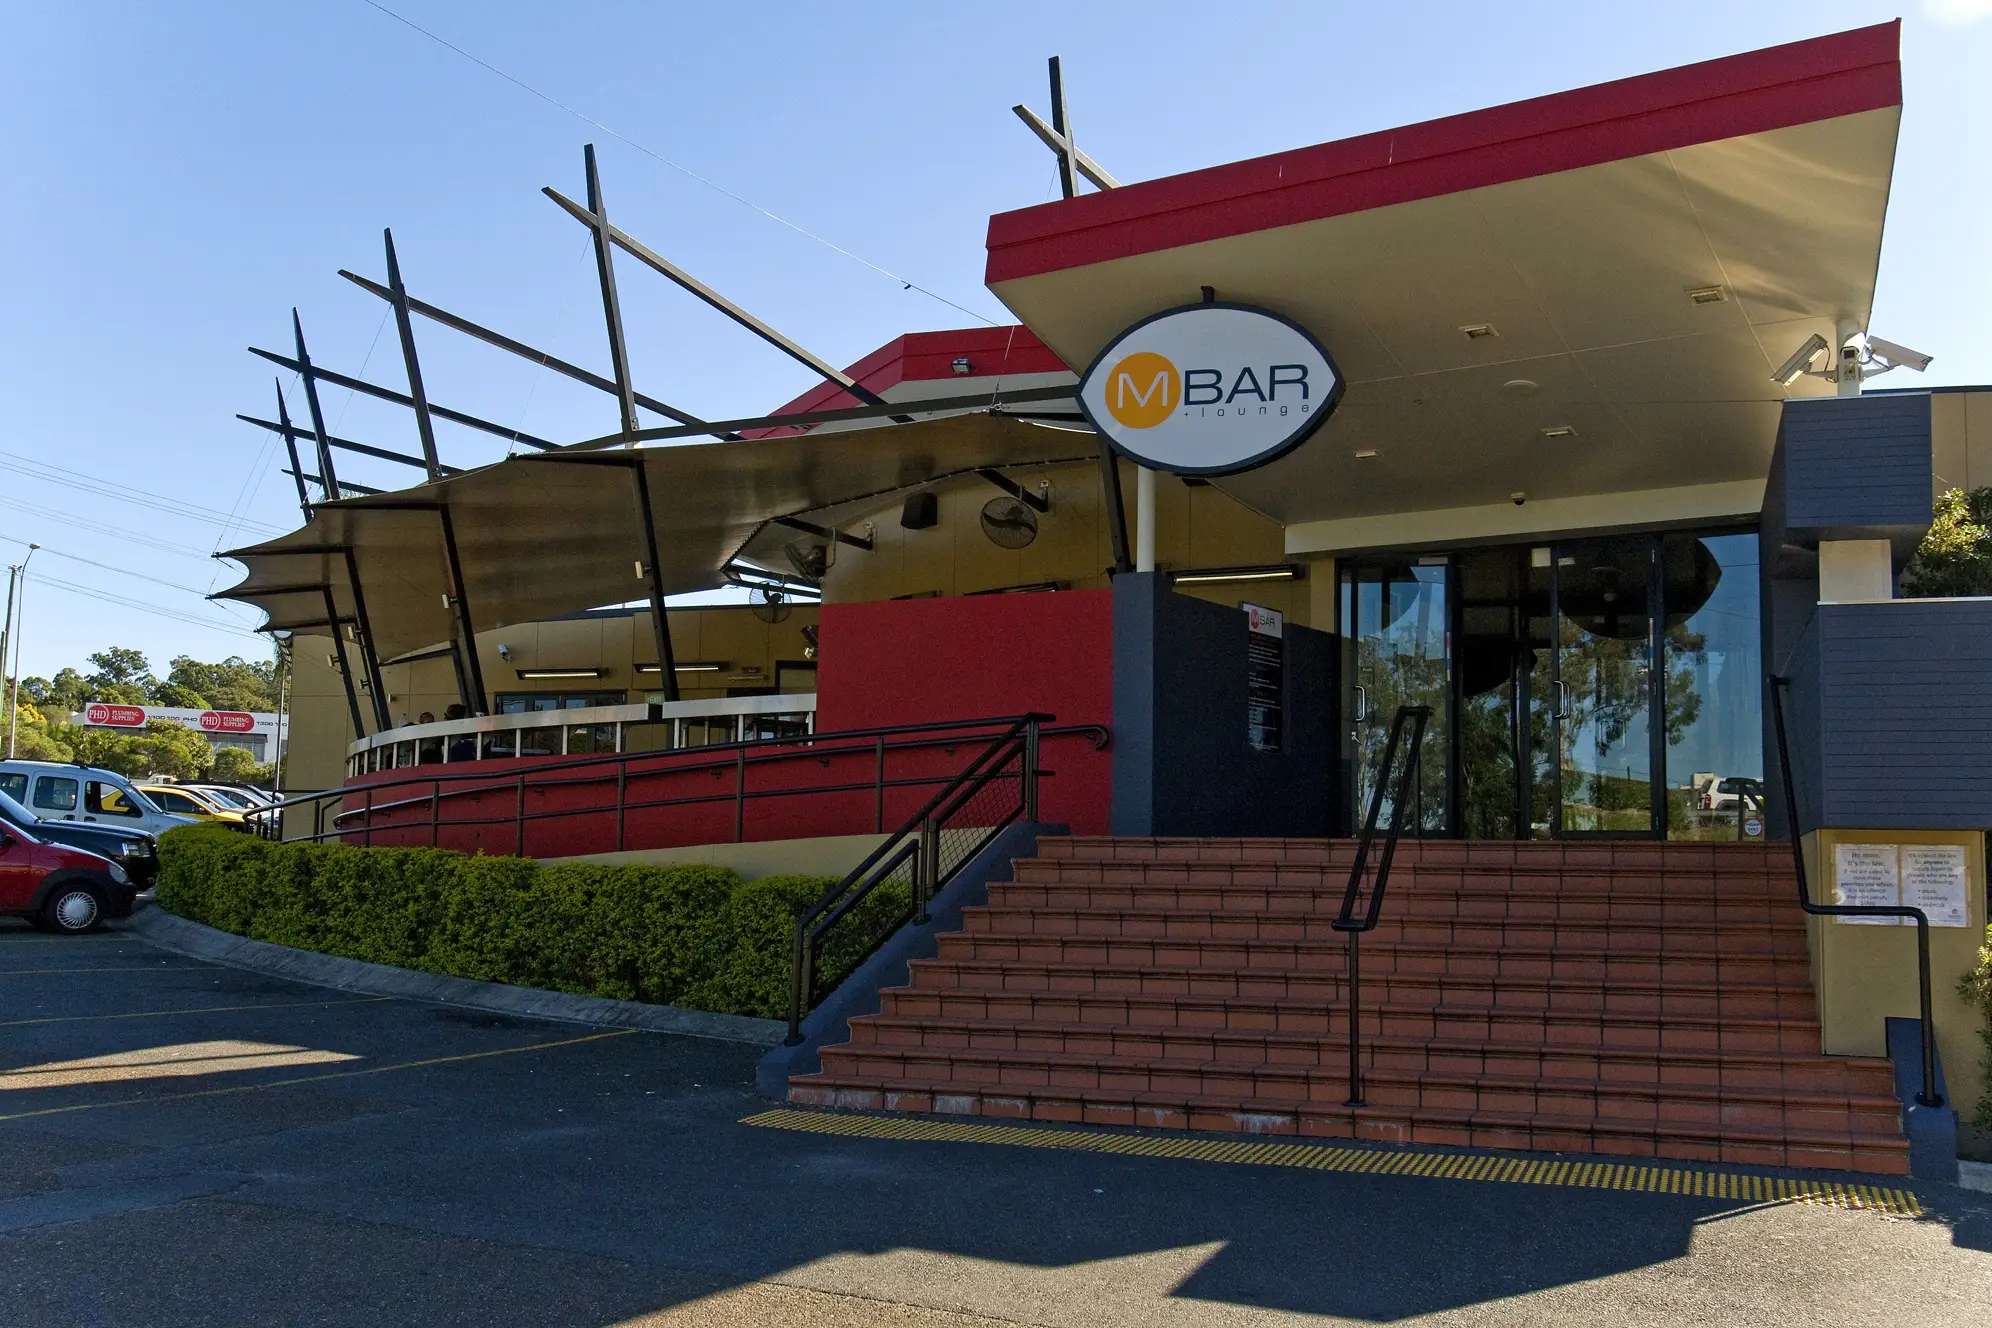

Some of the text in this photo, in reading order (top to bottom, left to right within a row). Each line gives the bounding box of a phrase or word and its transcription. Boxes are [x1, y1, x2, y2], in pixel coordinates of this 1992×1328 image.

[1117, 364, 1310, 409] M BAR
[88, 709, 107, 719] PHD
[112, 709, 140, 717] PLUMBING
[201, 716, 218, 726] PHD
